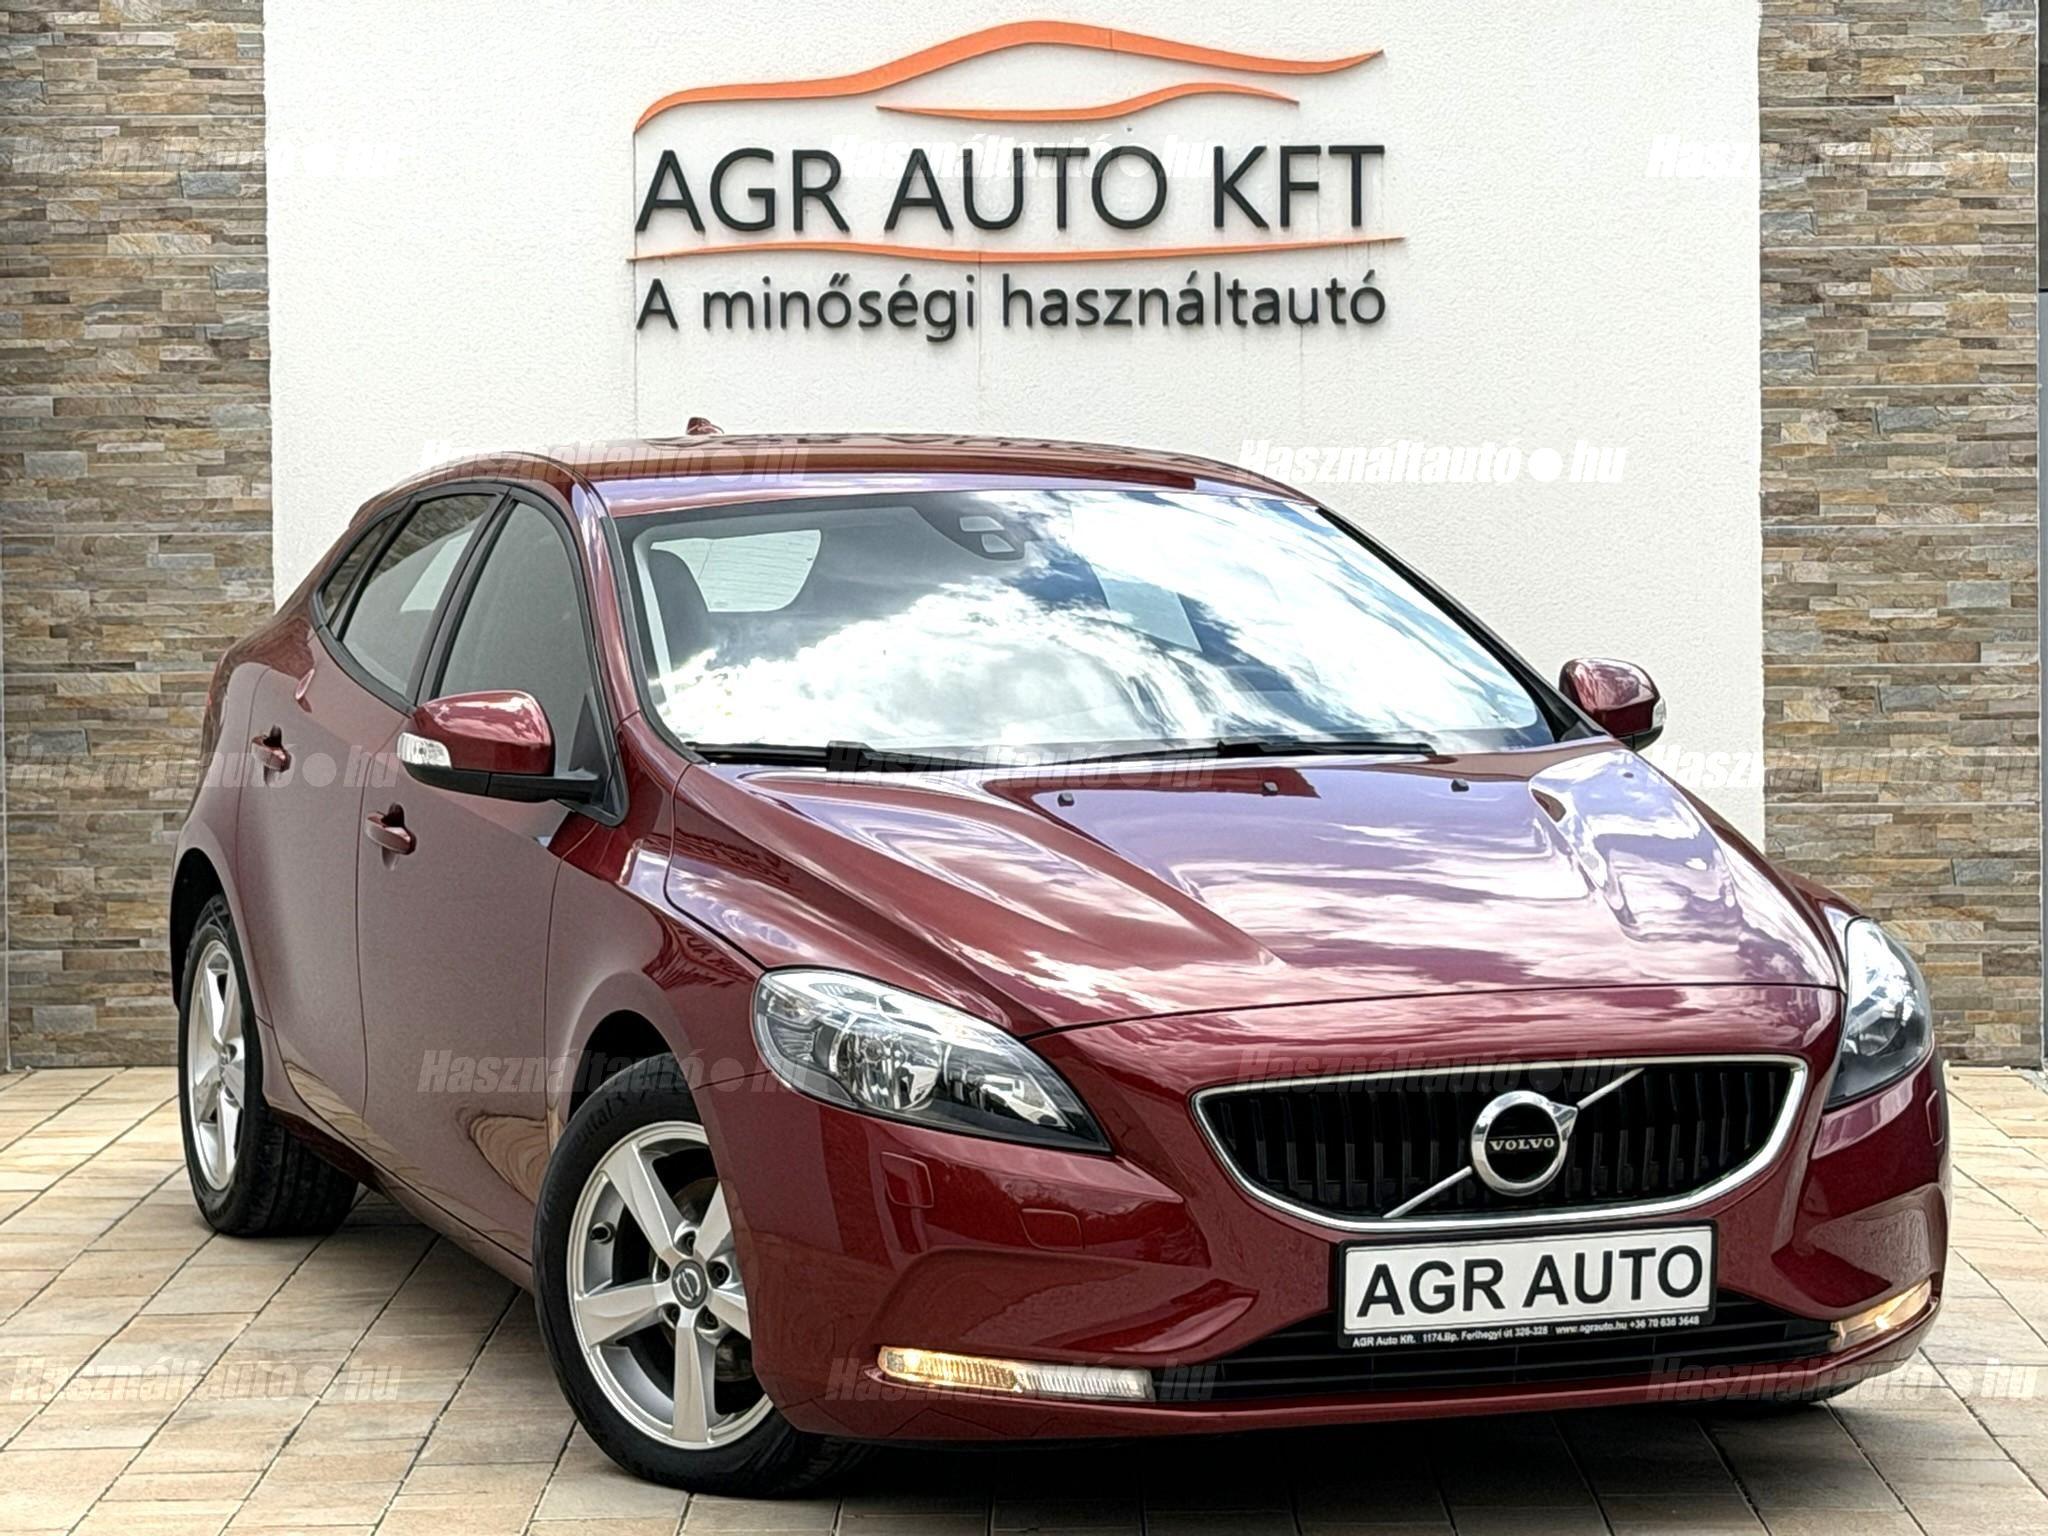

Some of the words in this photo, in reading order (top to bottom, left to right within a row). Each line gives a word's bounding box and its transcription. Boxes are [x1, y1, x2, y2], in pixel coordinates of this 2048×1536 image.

[635, 148, 851, 233] AGR
[884, 144, 1168, 232] AUTO
[1212, 144, 1386, 232] KFT
[635, 278, 678, 331] A
[701, 272, 976, 343] minőségi
[1002, 270, 1387, 329] használtautó
[1489, 1138, 1555, 1151] VOLVO
[1356, 1258, 1505, 1318] AGR
[1522, 1245, 1702, 1308] AUTO
